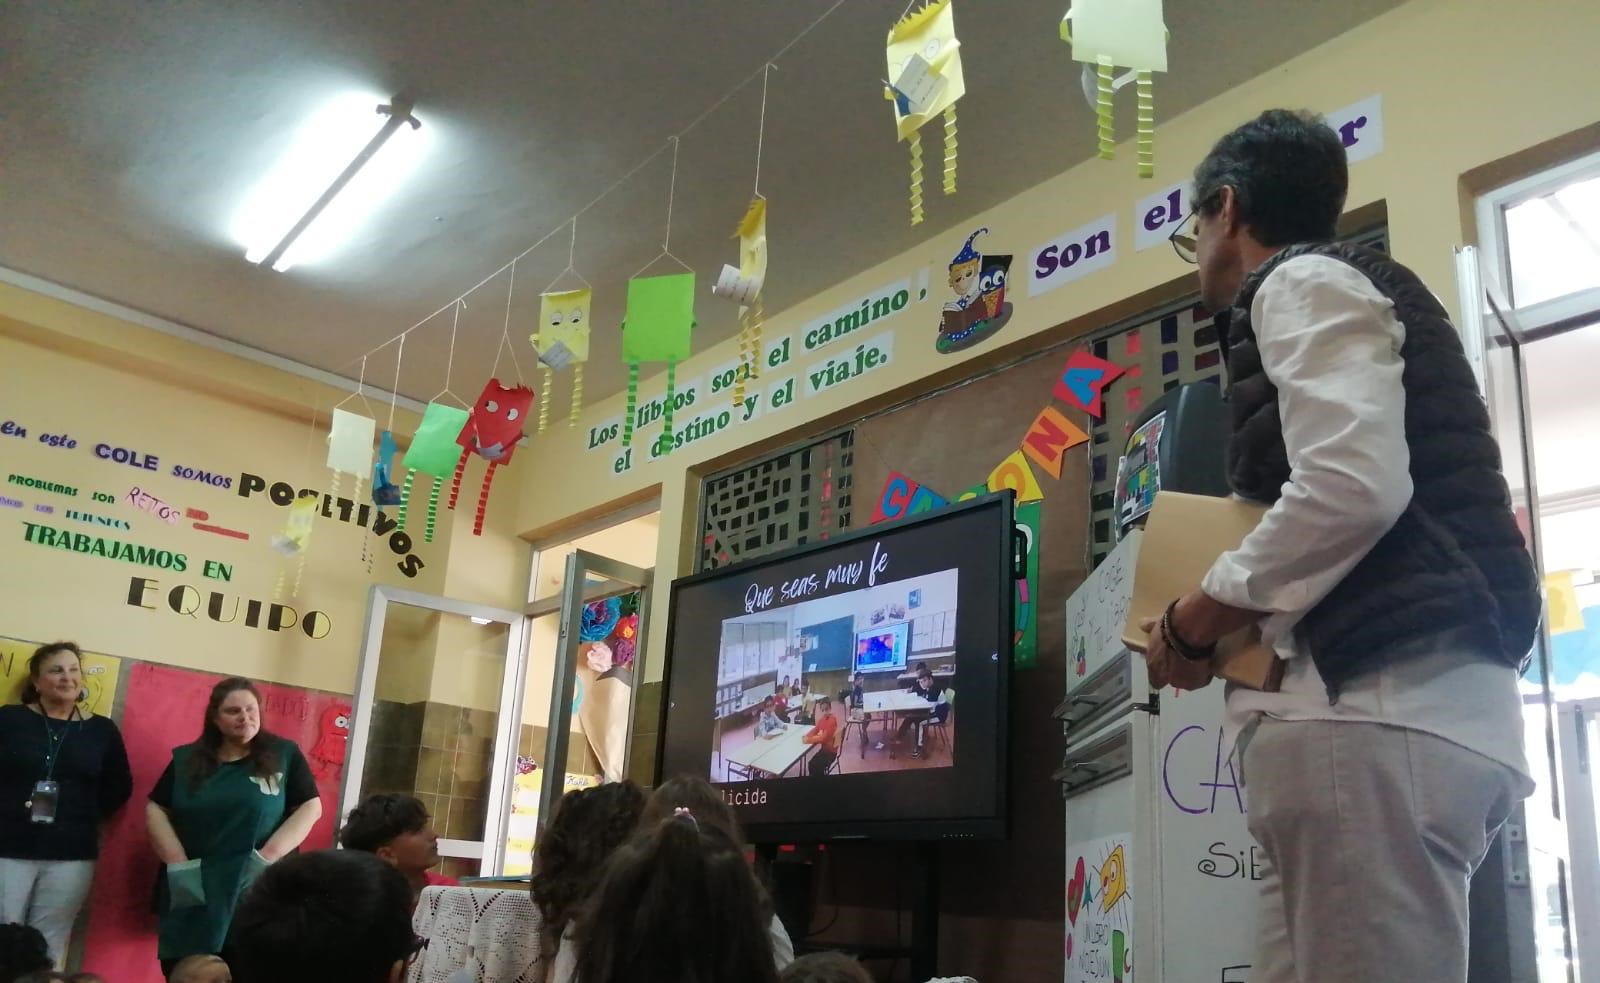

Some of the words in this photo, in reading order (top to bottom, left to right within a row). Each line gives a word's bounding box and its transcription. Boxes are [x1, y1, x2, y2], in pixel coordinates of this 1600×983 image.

[1035, 229, 1111, 279] Son
[1143, 188, 1183, 231] el
[588, 423, 619, 450] Los
[768, 337, 791, 367] el
[614, 449, 632, 474] el
[743, 394, 759, 421] y
[771, 378, 794, 408] el
[809, 344, 888, 391] viaje.
[1, 421, 27, 438] En
[39, 433, 77, 449] este
[95, 443, 159, 471] COLE
[125, 486, 181, 522] RETOS
[22, 521, 188, 573] TRABAJAMOS
[203, 559, 233, 582] EN
[744, 583, 774, 614] Que
[780, 572, 820, 603] seas
[825, 558, 864, 589] muy
[868, 541, 888, 587] fe
[127, 576, 332, 640] EQUIPO
